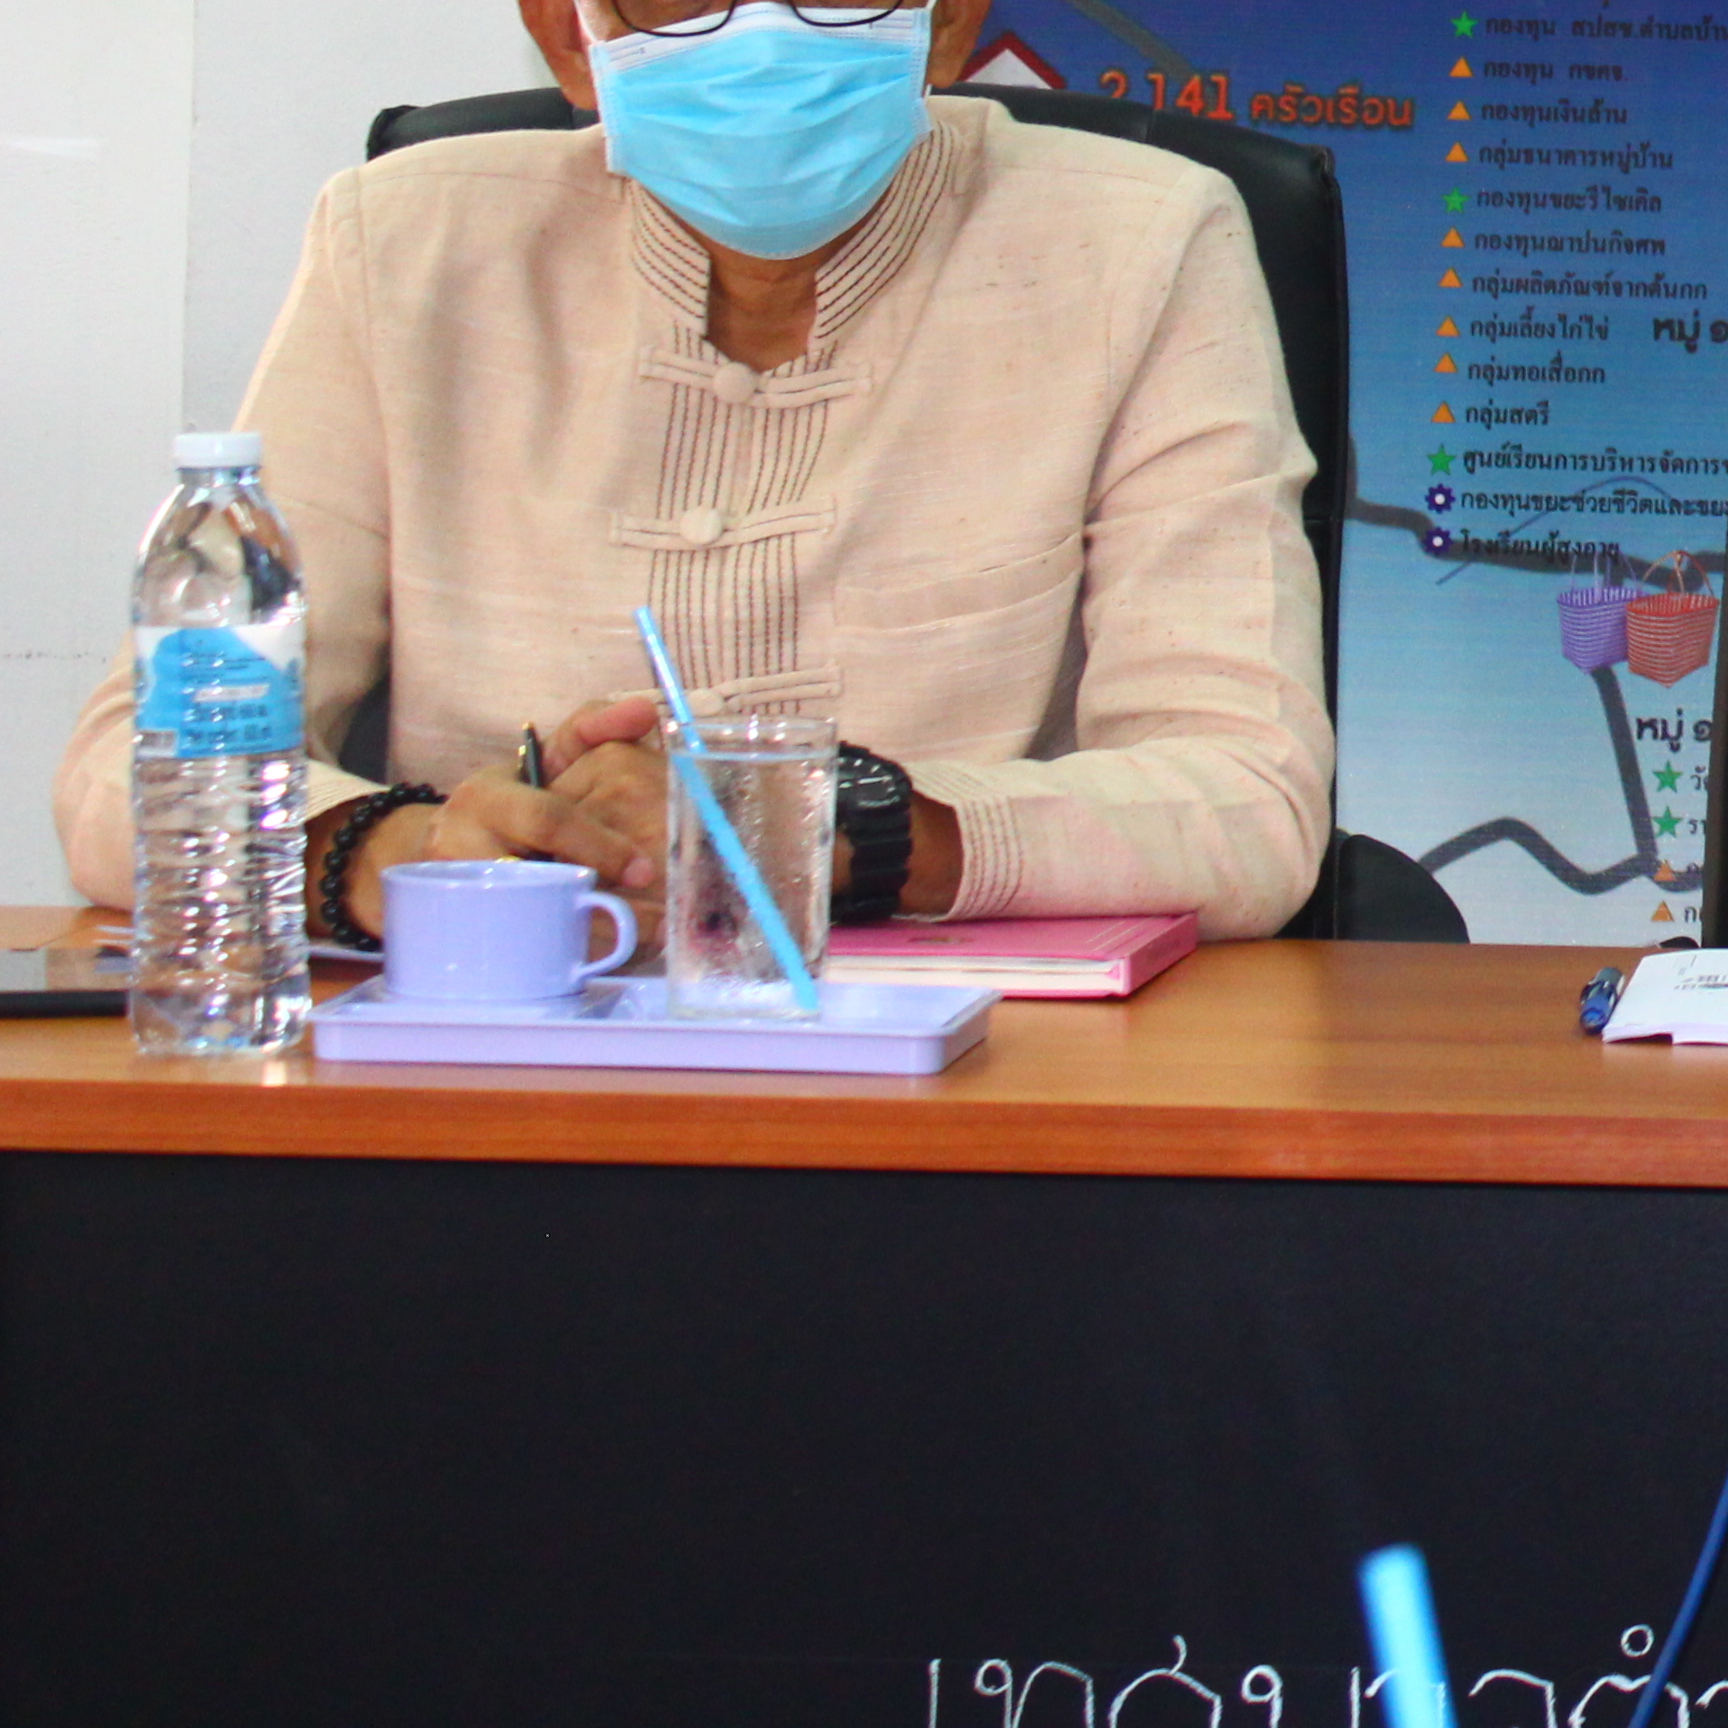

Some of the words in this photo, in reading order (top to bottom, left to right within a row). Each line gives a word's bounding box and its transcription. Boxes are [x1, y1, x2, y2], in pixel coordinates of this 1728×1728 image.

[1250, 80, 1414, 128] ครัวเรือน
[1653, 307, 1701, 354] หมู่
[1464, 398, 1550, 431] กลุ่มสตรี
[1635, 705, 1684, 754] หมู่
